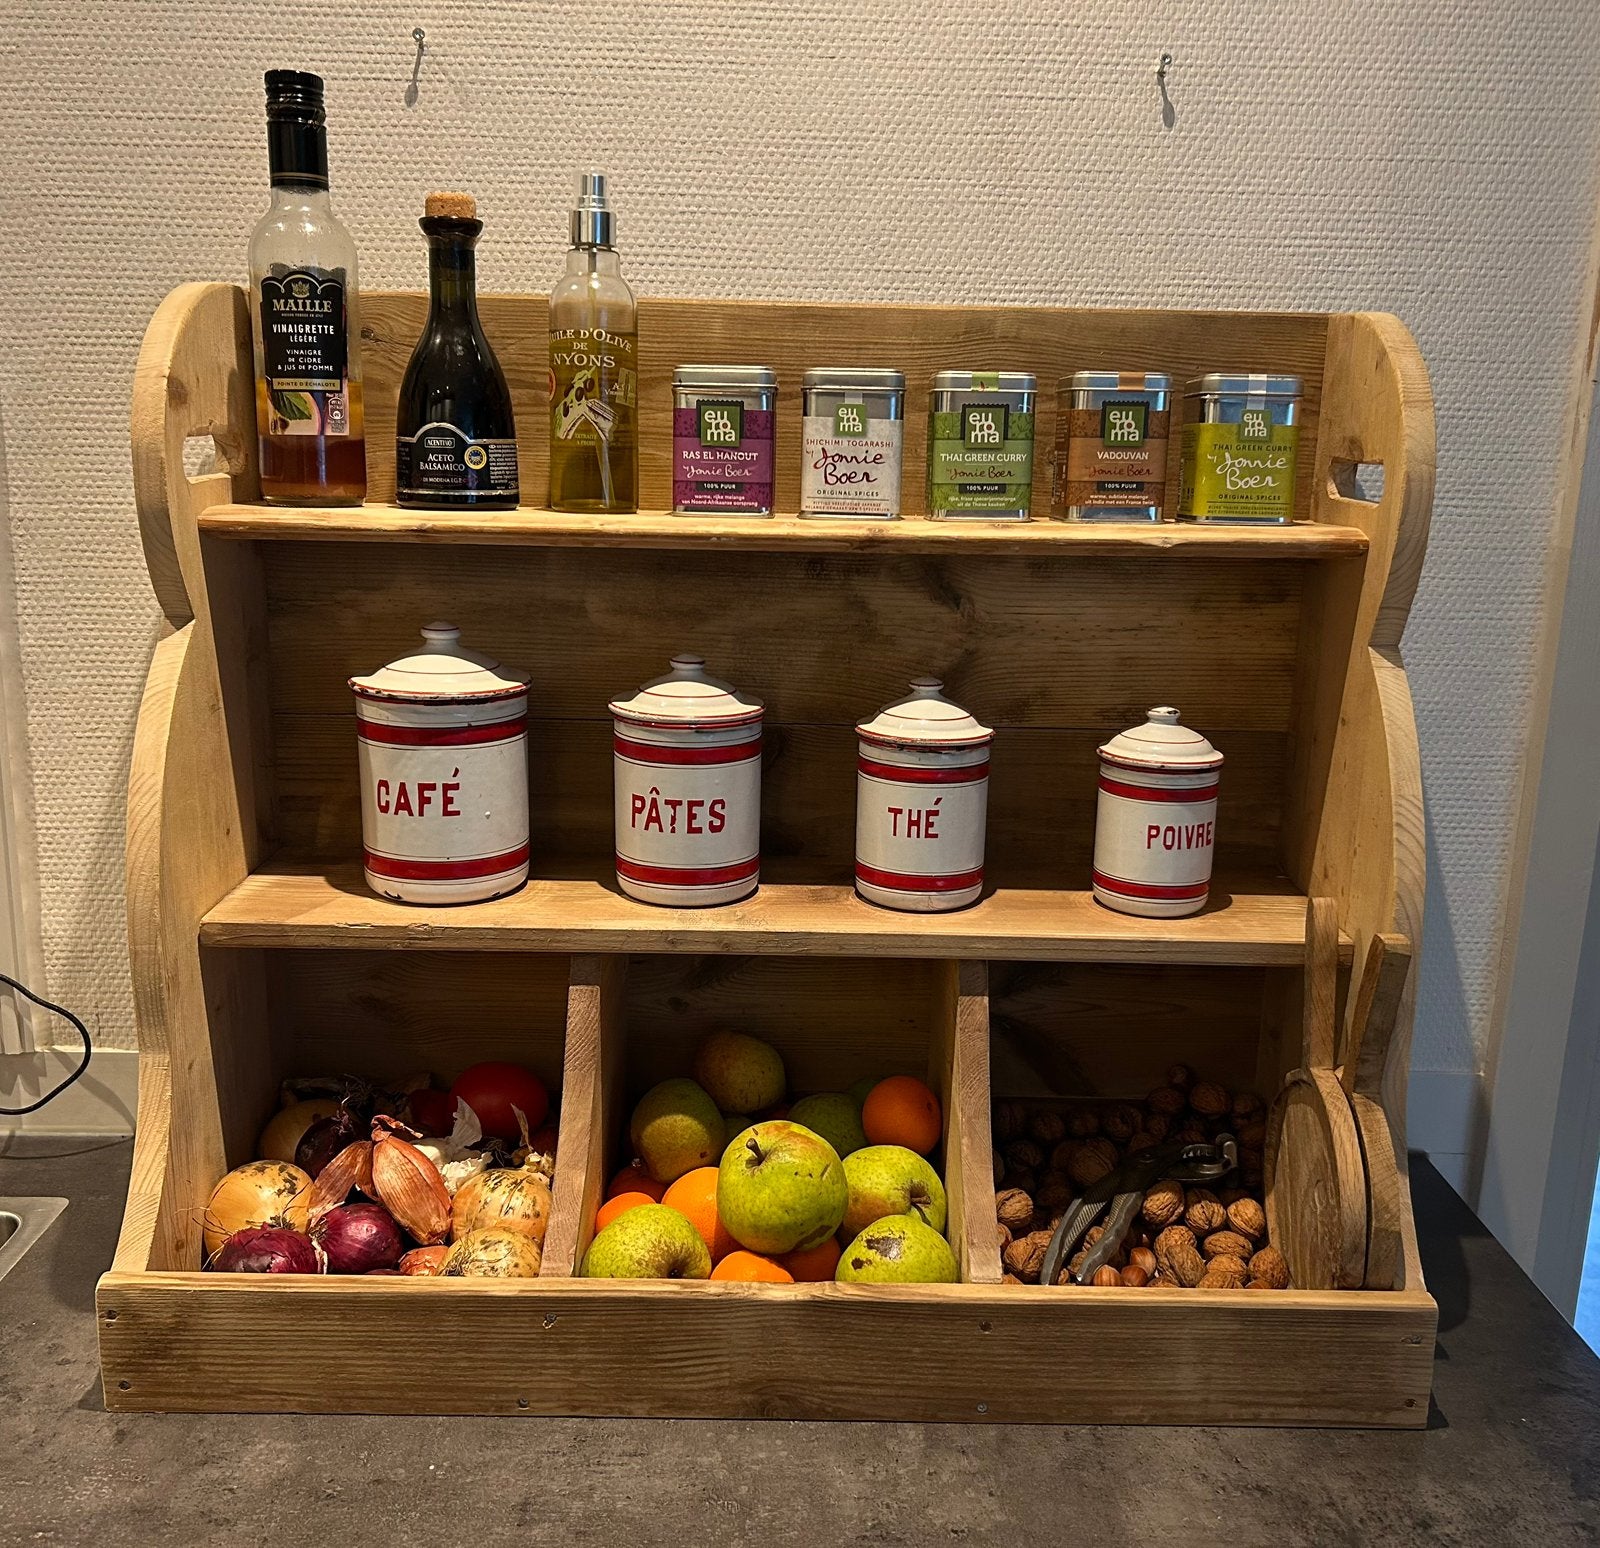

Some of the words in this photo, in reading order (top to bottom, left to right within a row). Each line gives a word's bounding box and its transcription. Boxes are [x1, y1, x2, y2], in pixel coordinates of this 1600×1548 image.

[272, 299, 332, 313] MAILLE
[272, 323, 335, 335] VINAIGRETTE
[290, 334, 318, 343] LÉGÈRE
[573, 342, 588, 350] DE
[553, 351, 616, 368] NYONS
[308, 364, 334, 372] POMME
[847, 440, 894, 448] TOGARASHI
[427, 452, 455, 462] ACETO
[683, 451, 700, 460] RAS
[703, 451, 714, 460] EL
[717, 452, 759, 461] HANOUT
[813, 447, 885, 470] Jonnie
[940, 453, 962, 462] THAI
[964, 453, 995, 462] GREEN
[996, 453, 1027, 462] CURRY
[1097, 451, 1149, 460] VADOUVAN
[419, 461, 466, 472] BALSAMICO
[1216, 451, 1288, 474] Jonnie
[824, 463, 878, 486] Boer
[1226, 467, 1280, 490] Boer
[377, 767, 461, 817] CAFÉ
[632, 786, 726, 834] PÂTES
[887, 797, 943, 839] THÉ
[1147, 821, 1213, 850] POIVRE
